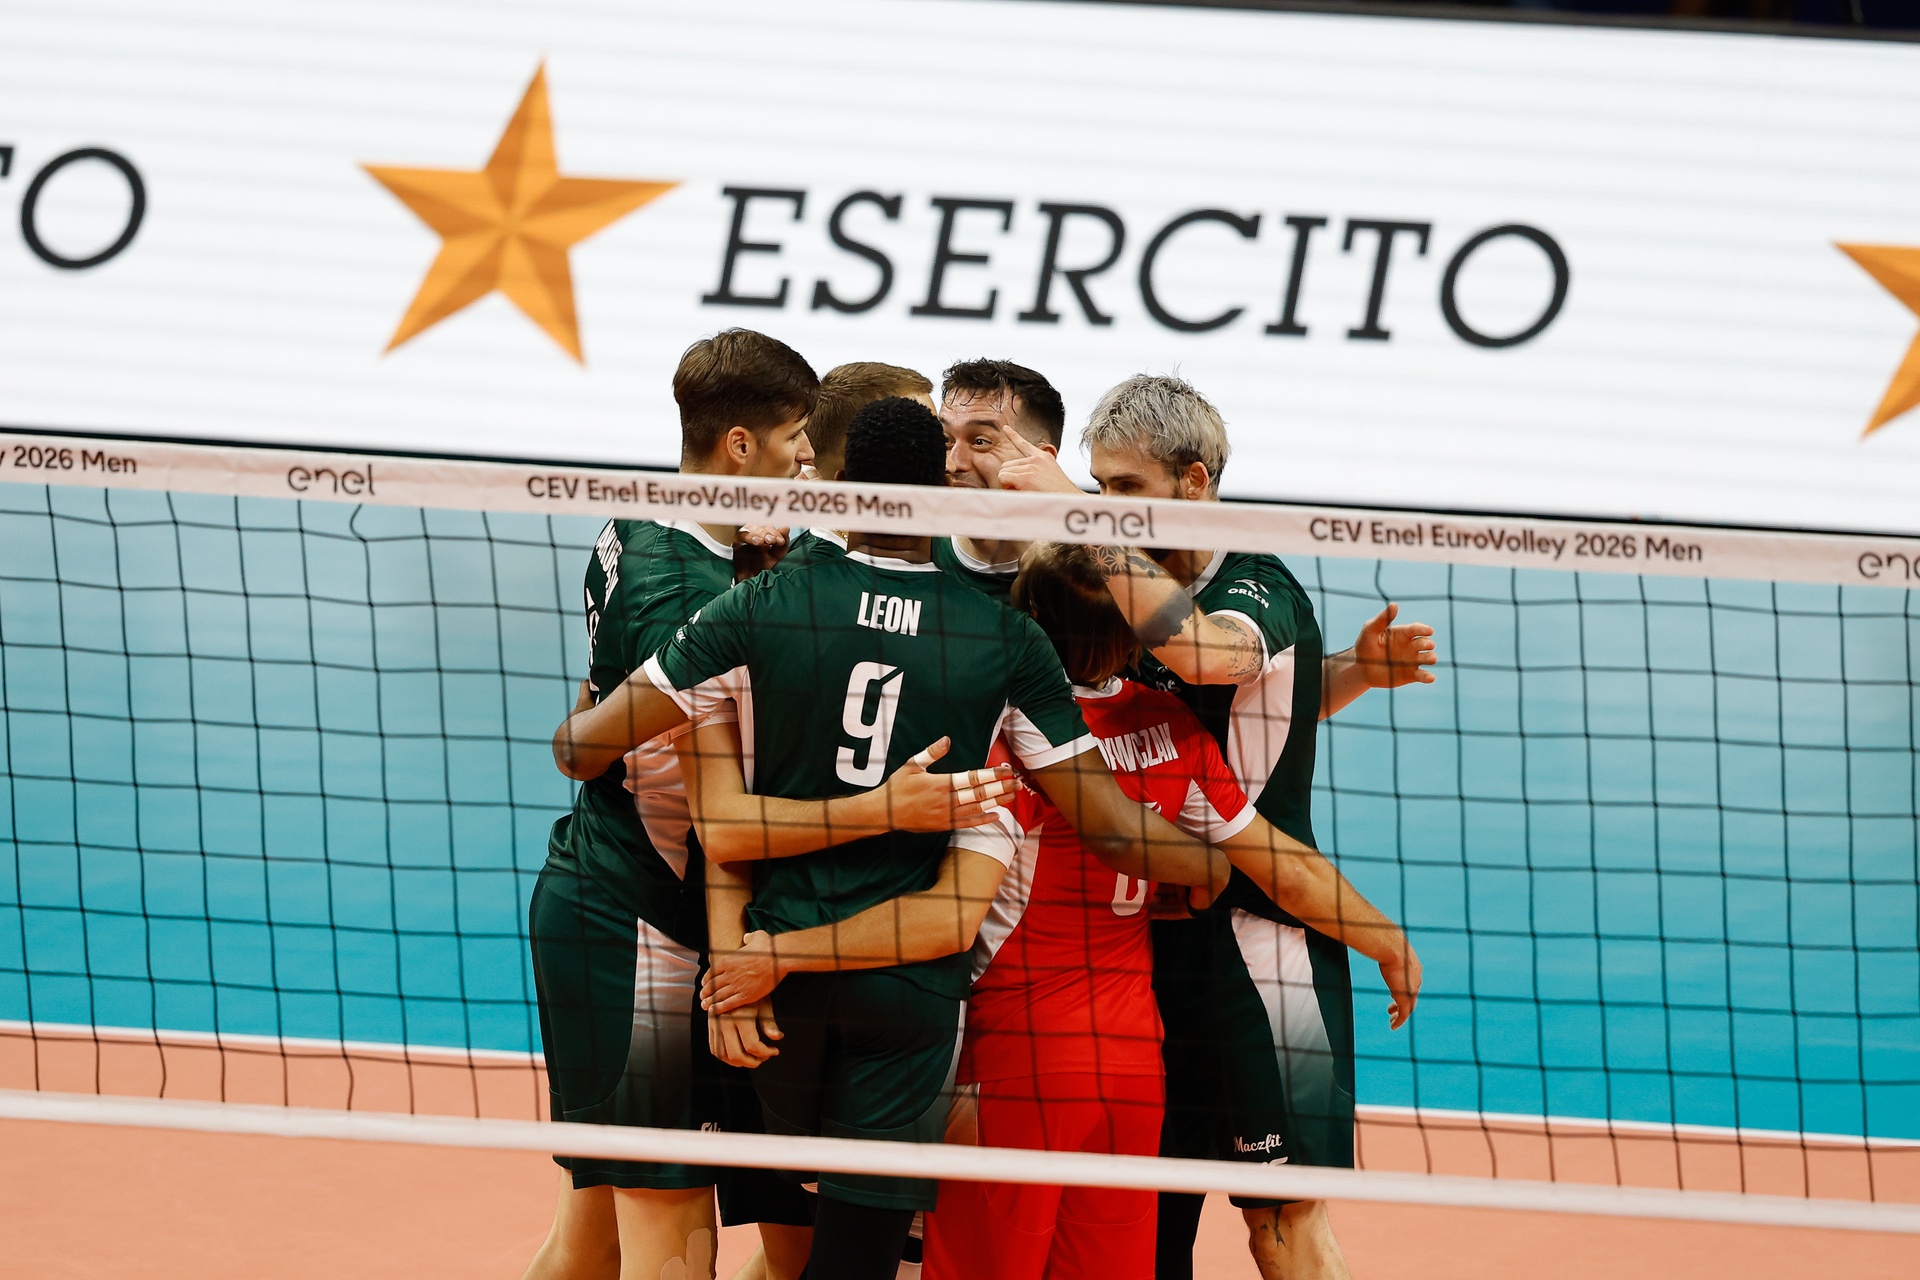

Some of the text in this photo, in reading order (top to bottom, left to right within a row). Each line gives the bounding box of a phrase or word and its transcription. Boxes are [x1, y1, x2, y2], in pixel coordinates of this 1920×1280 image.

[0, 145, 146, 270] O
[699, 186, 1570, 350] ESERCITO
[12, 445, 74, 470] 2026
[81, 449, 138, 474] Men
[287, 463, 375, 496] enel
[526, 475, 914, 519] CEV Enel EuroVolley 2026 Men
[1064, 505, 1155, 538] enel
[1309, 517, 1703, 561] CEV Enel EuroVolley 2026 Men
[856, 591, 922, 637] LEON
[1227, 587, 1270, 609] ORLEN
[835, 661, 904, 788] 9
[1233, 1133, 1283, 1154] Maczfit
